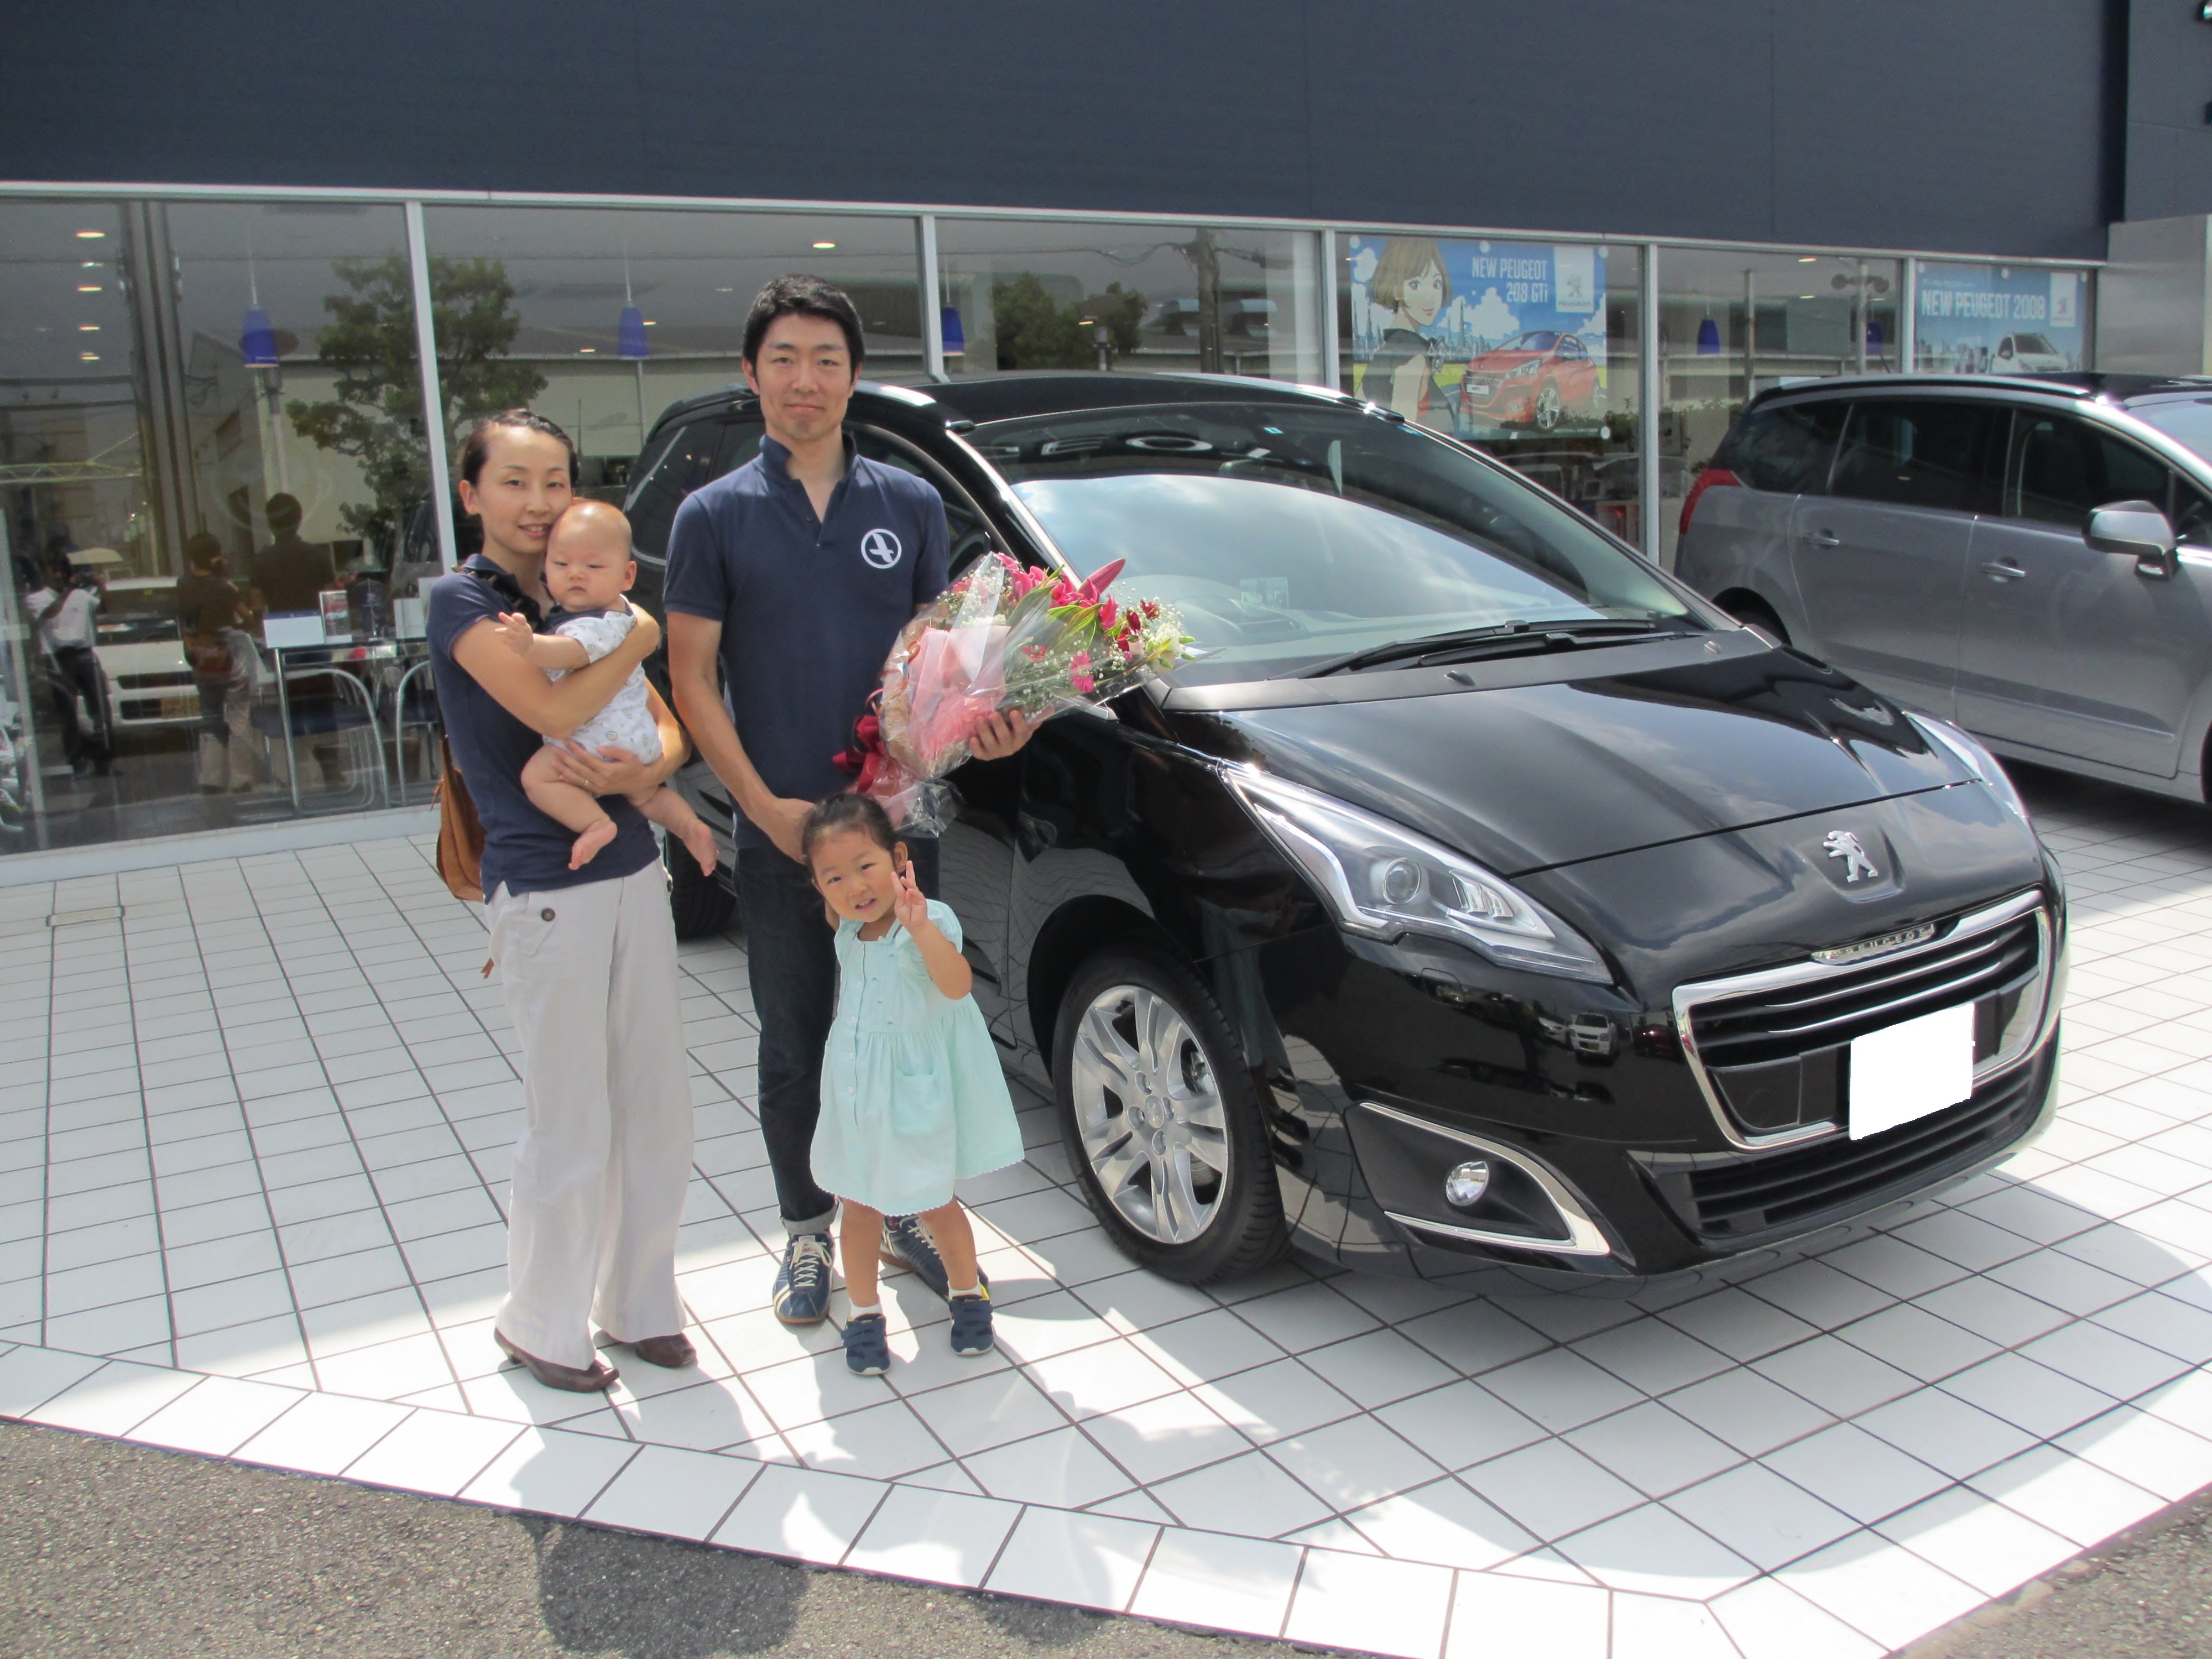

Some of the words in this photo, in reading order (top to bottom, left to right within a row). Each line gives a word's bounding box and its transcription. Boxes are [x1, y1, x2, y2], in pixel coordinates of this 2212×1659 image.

[1472, 257, 1497, 278] NEW
[1500, 258, 1547, 280] PEUGEOT
[1506, 282, 1529, 302] 208
[1531, 283, 1548, 303] GTi
[1921, 289, 1953, 316] NEW
[1955, 291, 2011, 319] PEUGEOT
[2012, 294, 2045, 320] 2008
